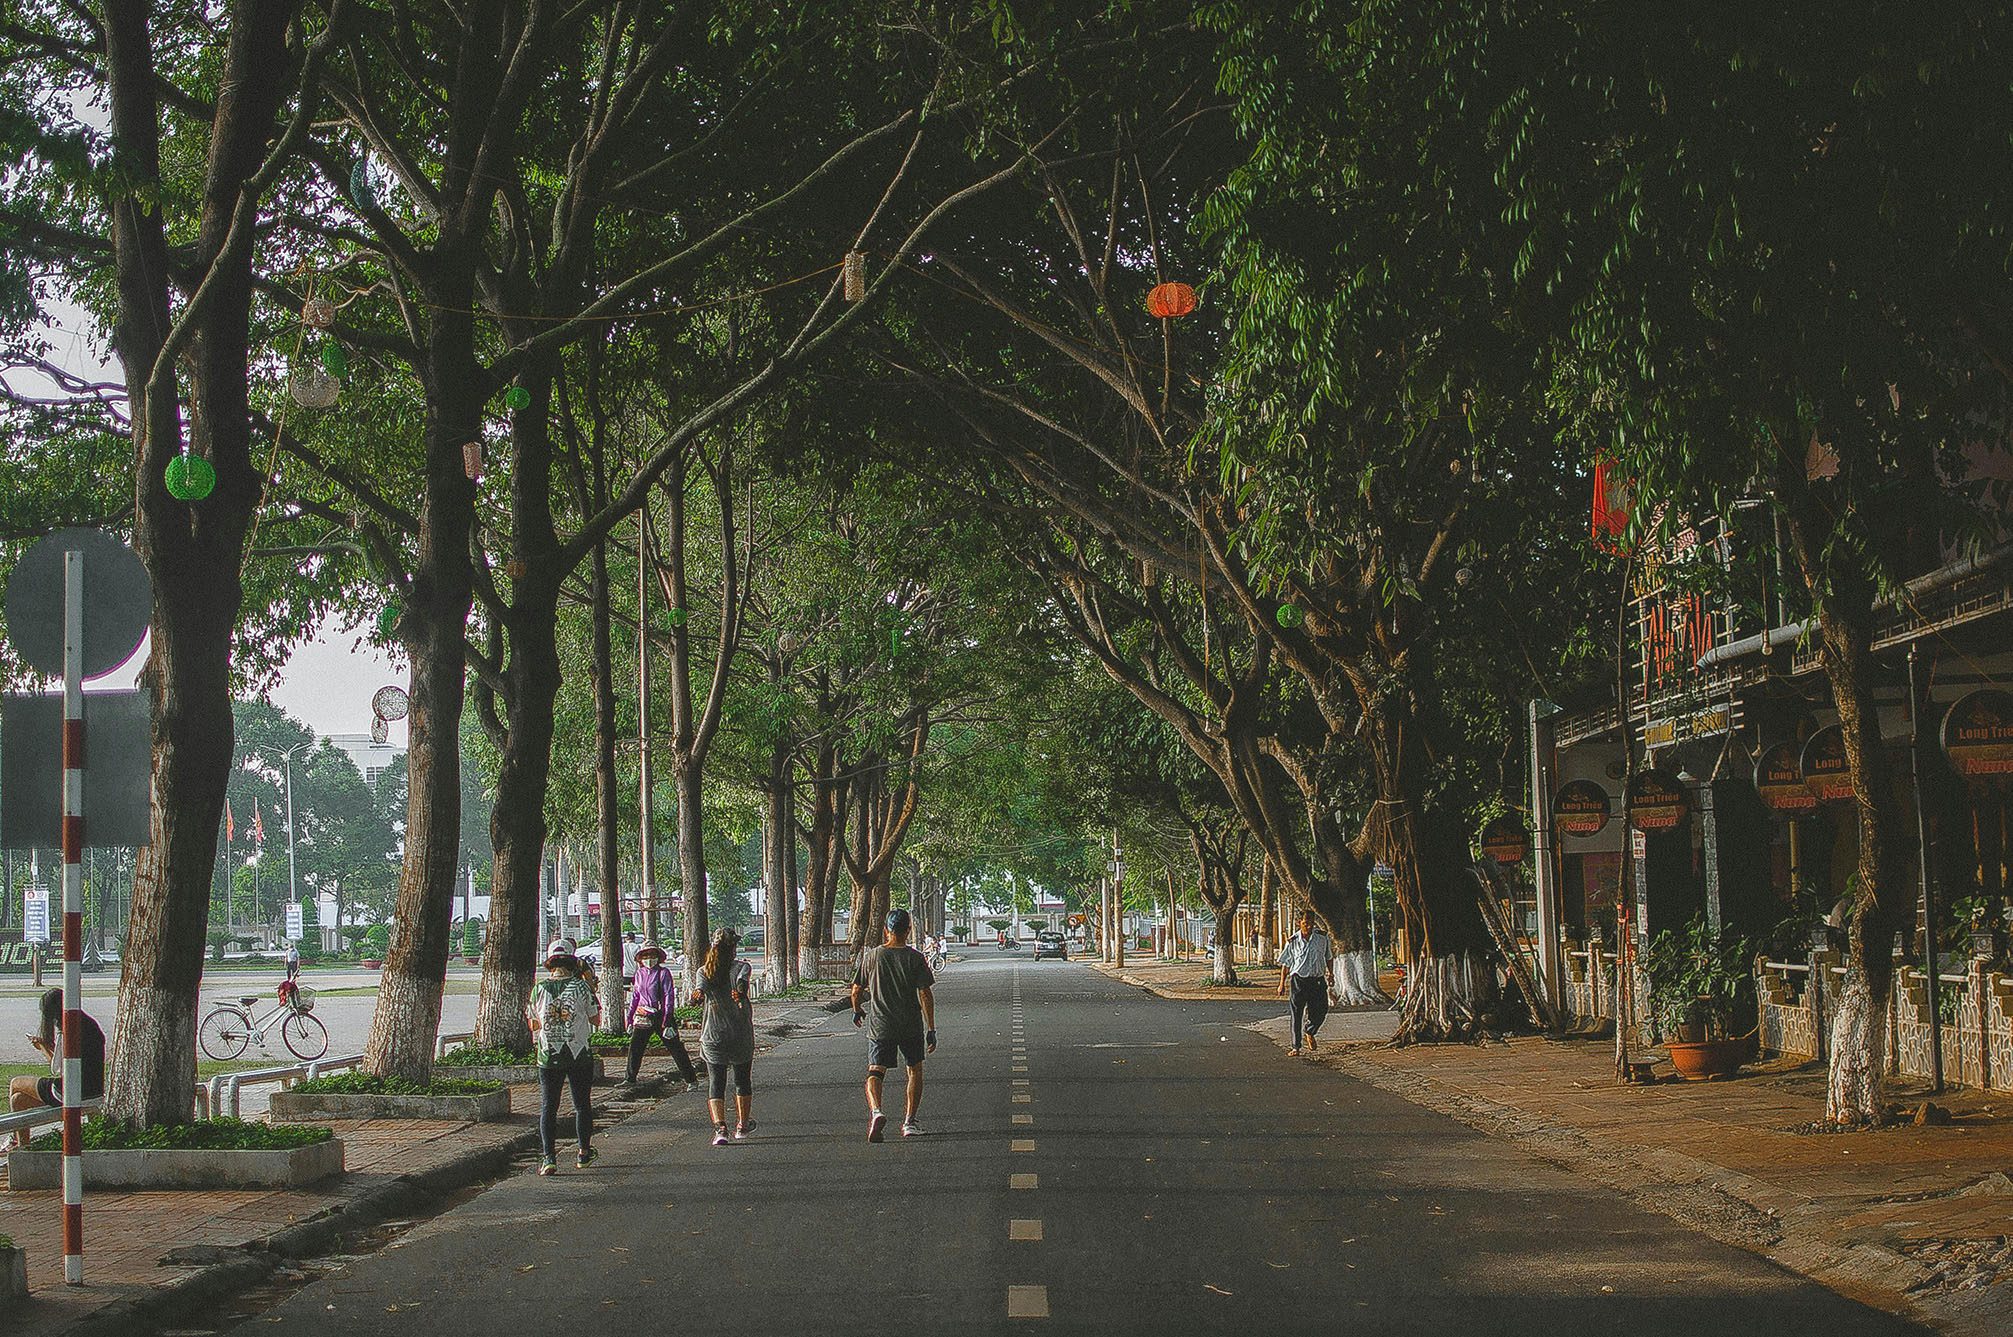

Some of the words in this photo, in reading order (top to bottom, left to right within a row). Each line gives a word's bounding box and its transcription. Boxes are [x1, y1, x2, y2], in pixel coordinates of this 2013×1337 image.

[1959, 727, 1989, 740] Long
[1815, 759, 1842, 769] Long
[1768, 770, 1793, 781] Long
[1633, 795, 1655, 804] Long
[1562, 802, 1581, 810] Long
